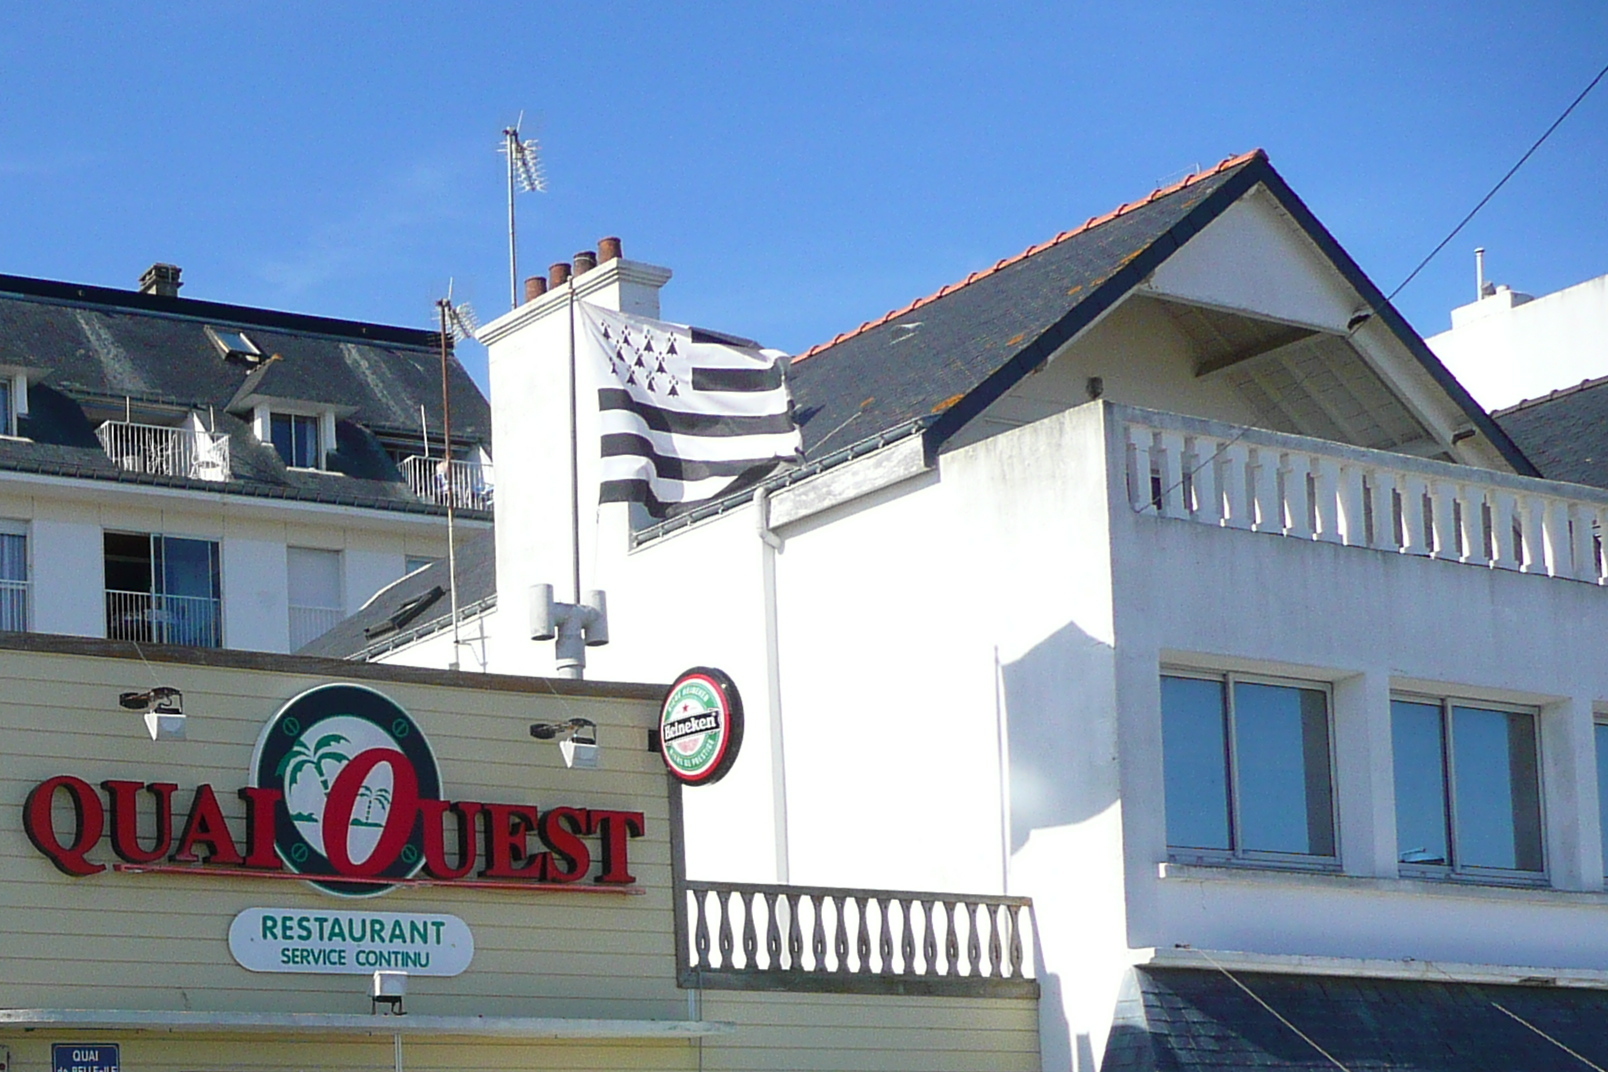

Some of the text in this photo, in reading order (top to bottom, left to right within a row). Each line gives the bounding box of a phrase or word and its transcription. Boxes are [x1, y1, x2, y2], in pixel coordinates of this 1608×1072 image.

[663, 714, 717, 741] Heineken
[23, 747, 645, 885] QUAI OUEST
[261, 914, 446, 946] RESTAURANT
[280, 948, 431, 968] SERVICE CONTINU
[72, 1049, 99, 1062] QUAI
